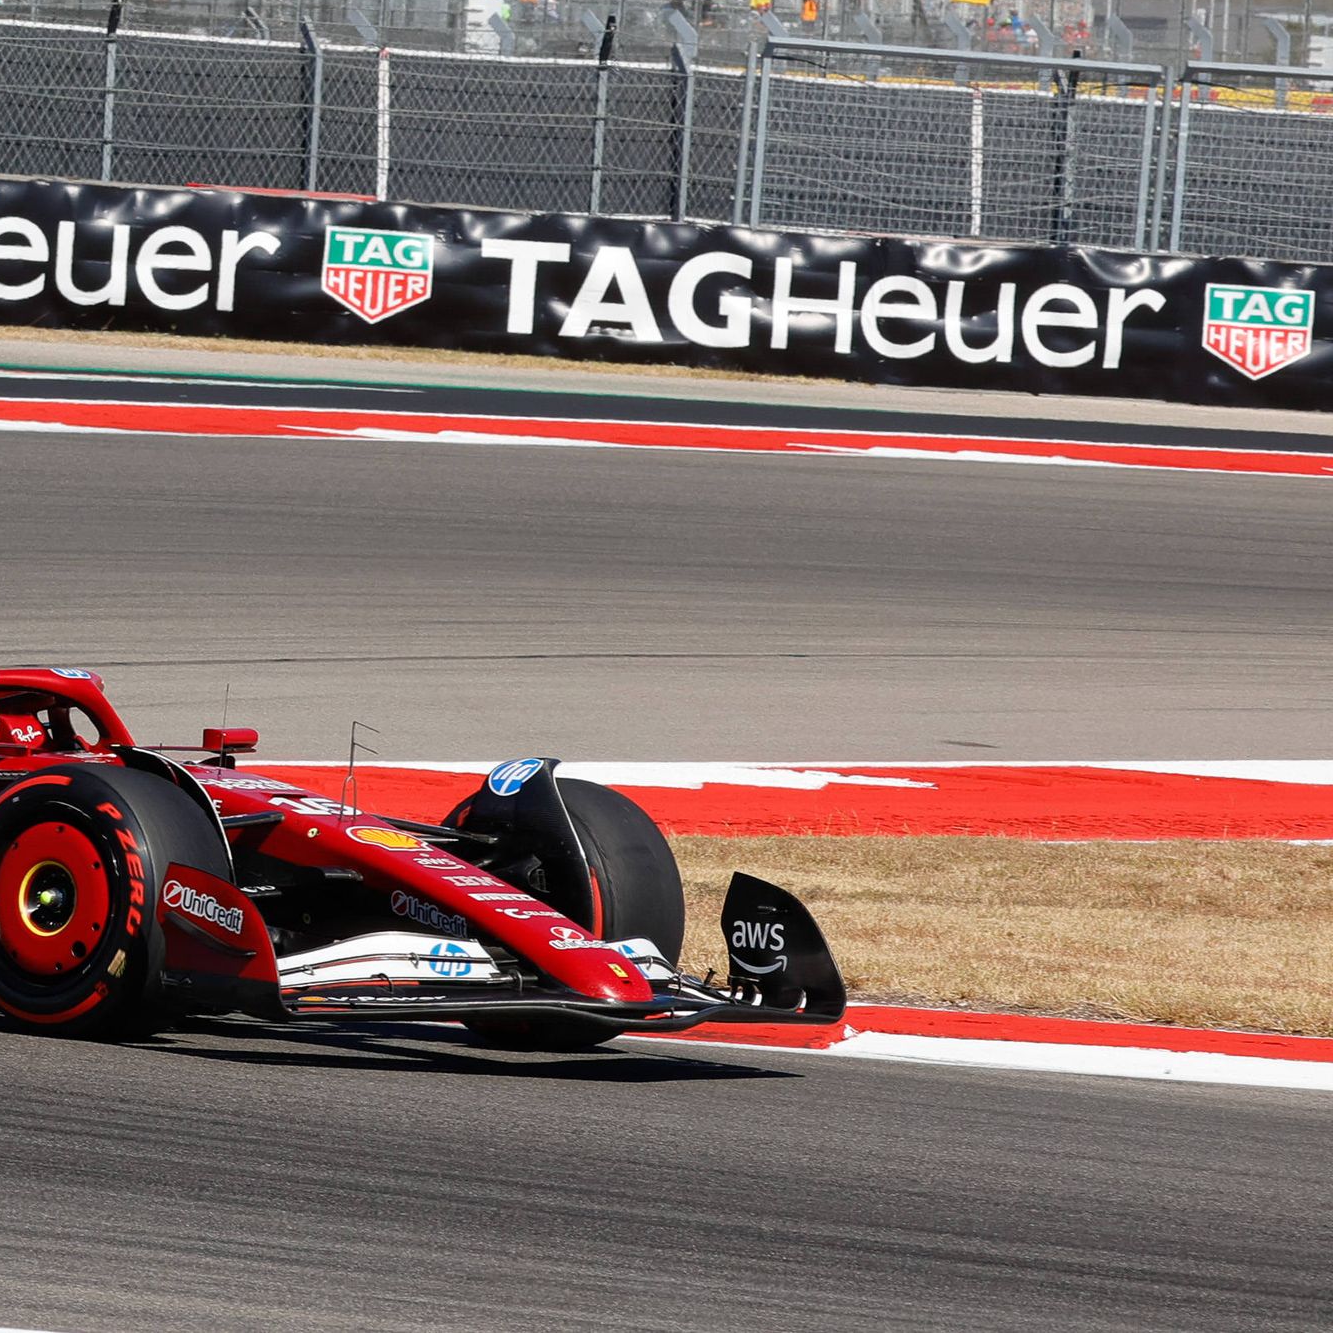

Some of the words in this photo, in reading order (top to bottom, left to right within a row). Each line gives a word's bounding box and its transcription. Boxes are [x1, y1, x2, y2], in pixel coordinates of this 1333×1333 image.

[334, 232, 425, 267] TAG
[326, 268, 425, 314] HEUER
[1213, 289, 1306, 324] TAG
[1206, 325, 1307, 371] HEUER
[96, 802, 124, 820] P
[115, 827, 145, 937] ZERO
[181, 886, 244, 935] UniCredit
[409, 896, 468, 938] UniCredit
[733, 919, 785, 952] aws
[429, 942, 471, 976] hp
